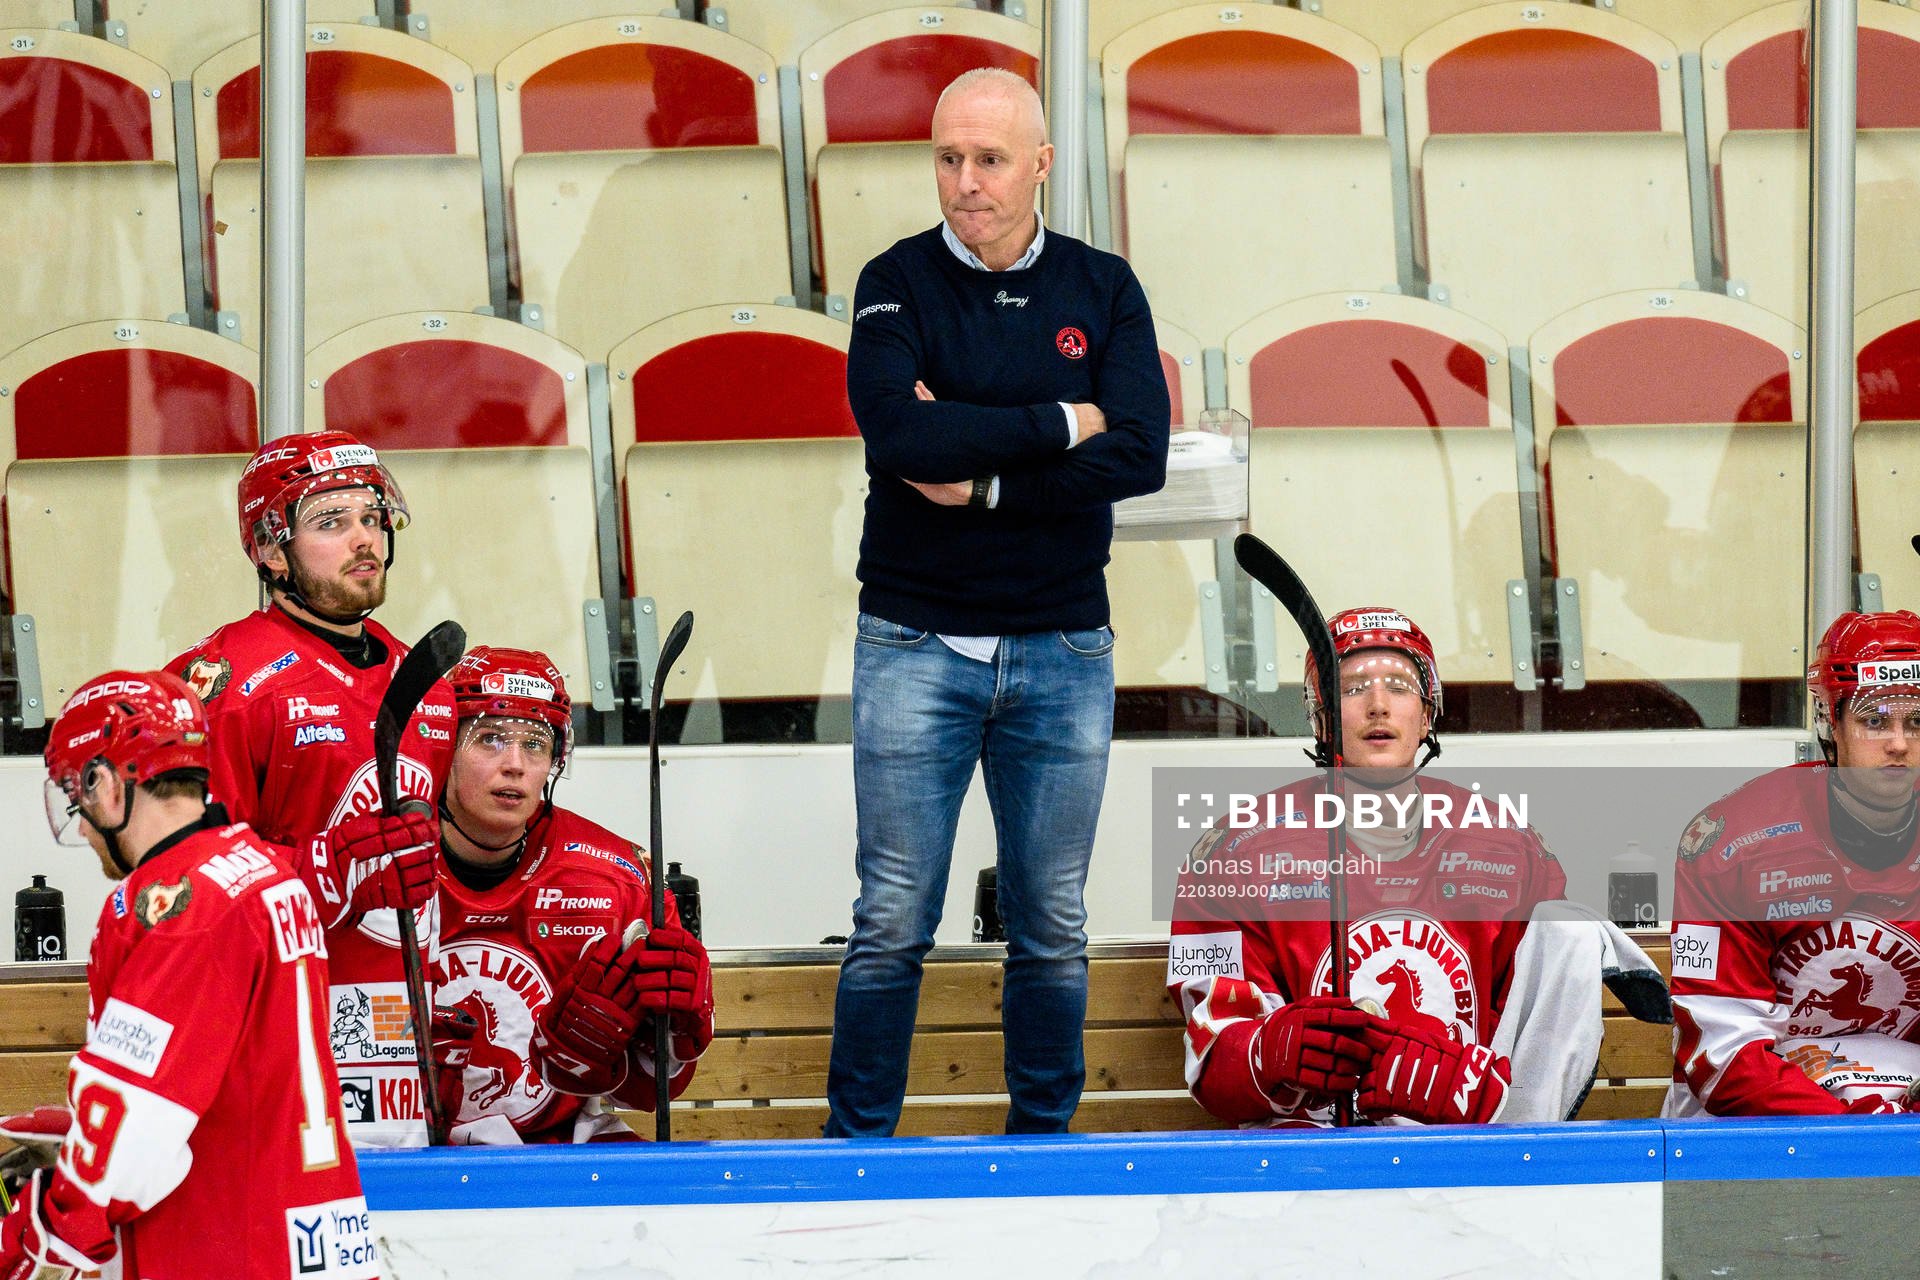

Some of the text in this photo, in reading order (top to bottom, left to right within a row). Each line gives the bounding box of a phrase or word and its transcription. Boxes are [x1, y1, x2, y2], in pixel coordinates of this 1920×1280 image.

[926, 16, 937, 24] 34
[1224, 12, 1236, 20] 35
[1527, 11, 1538, 19] 36
[624, 25, 635, 33] 33
[317, 32, 329, 40] 32
[16, 40, 27, 48] 31
[1352, 299, 1363, 307] 35
[1655, 298, 1667, 306] 36
[738, 312, 750, 321] 33
[429, 320, 441, 328] 32
[121, 329, 131, 337] 31
[335, 449, 374, 459] SVENSKA
[245, 496, 265, 512] CCM
[508, 677, 554, 690] SVENSKA
[508, 686, 532, 696] SPEL
[68, 729, 101, 749] CCM
[1731, 822, 1802, 849] INTERSPORT
[579, 844, 645, 885] INTERSPORT
[1375, 877, 1420, 886] CCM
[1460, 883, 1509, 899] ŠKODA
[1634, 903, 1656, 922] iQ
[1766, 895, 1832, 921] Atteviks
[464, 915, 509, 924] CCM
[552, 924, 607, 936] ŠKODA
[37, 935, 61, 955] iQ
[1674, 935, 1709, 956] gby
[1172, 944, 1233, 963] Ljungby
[1172, 960, 1240, 976] kommun
[1674, 954, 1713, 970] mun
[1788, 1024, 1823, 1036] 948
[376, 1044, 415, 1059] Lagans
[331, 1209, 369, 1235] Yme
